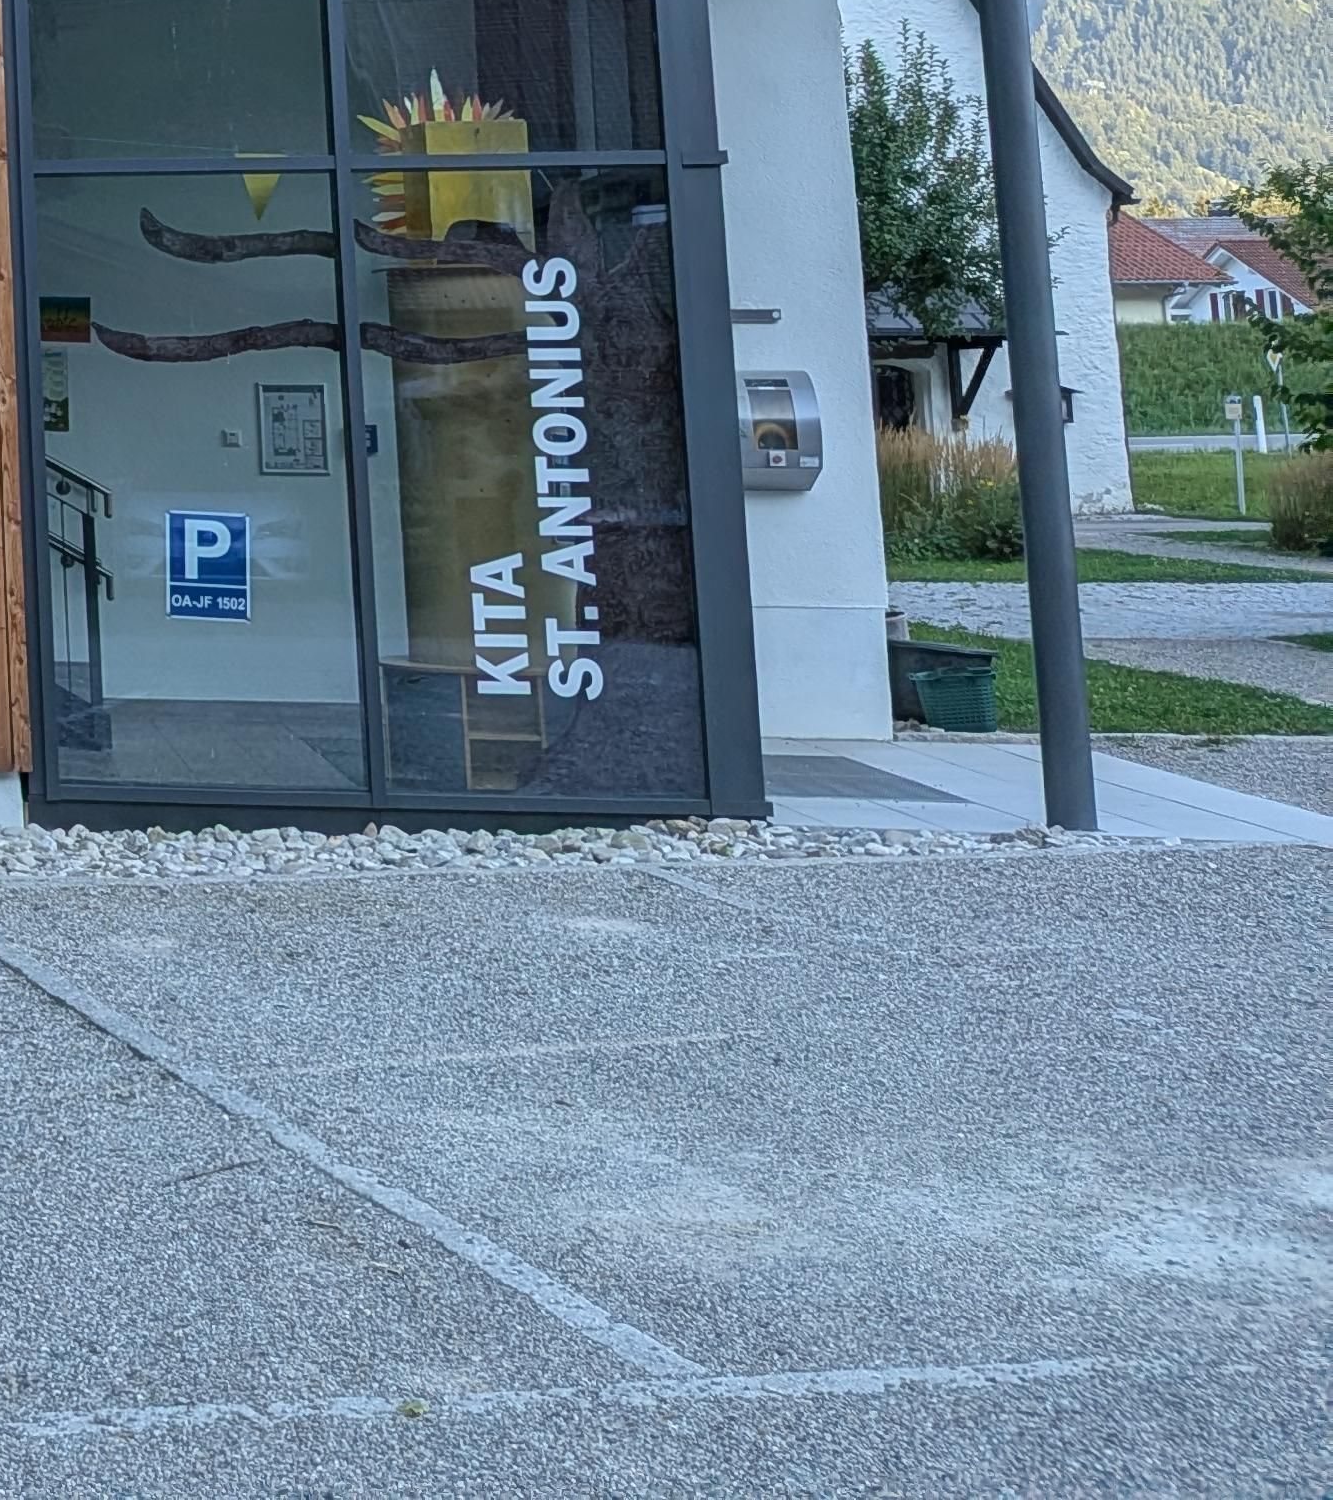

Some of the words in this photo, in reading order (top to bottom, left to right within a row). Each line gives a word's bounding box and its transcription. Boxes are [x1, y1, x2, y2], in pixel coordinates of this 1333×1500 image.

[522, 256, 597, 586] ANTONIUS
[184, 518, 232, 580] P
[171, 594, 213, 609] OA-JF
[217, 596, 246, 611] 1502
[470, 551, 532, 695] KITA
[545, 606, 604, 701] ST.
